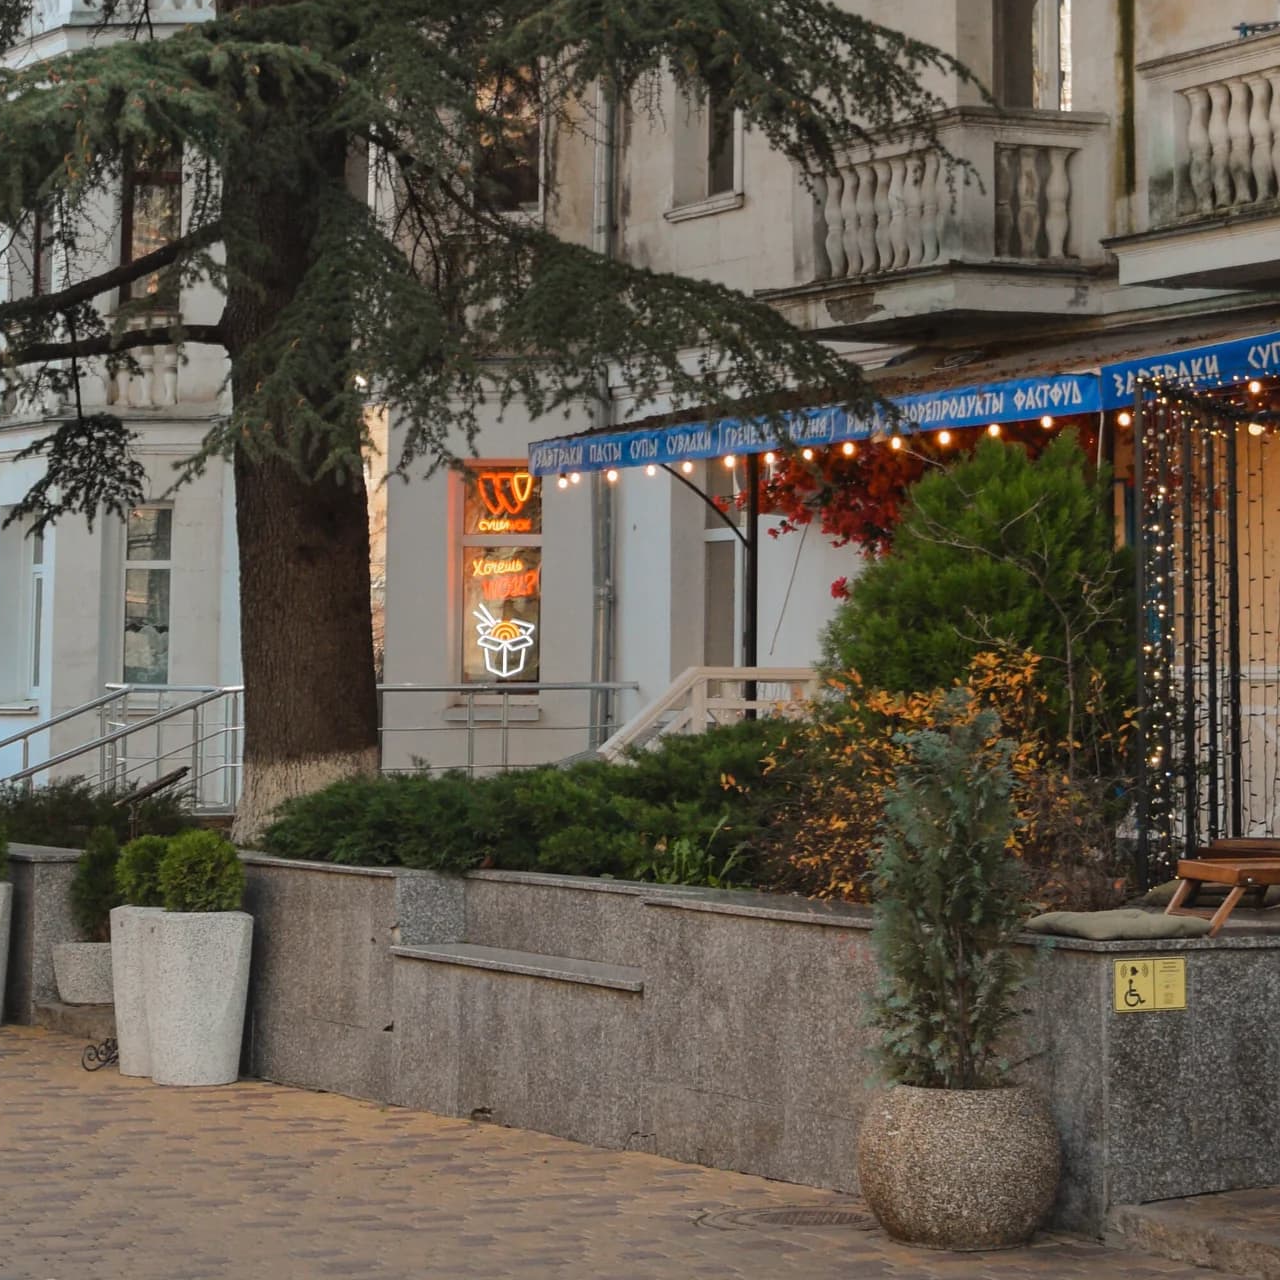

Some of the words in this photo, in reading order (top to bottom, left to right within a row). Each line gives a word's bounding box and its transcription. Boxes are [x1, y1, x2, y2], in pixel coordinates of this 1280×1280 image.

[534, 446, 584, 467] ЗАВТРАКИ
[589, 442, 622, 463] ПАСТЫ
[630, 438, 659, 459] СУПЫ
[666, 431, 711, 455] СУВЛАКИ
[1012, 380, 1083, 411] ФАСТФУД
